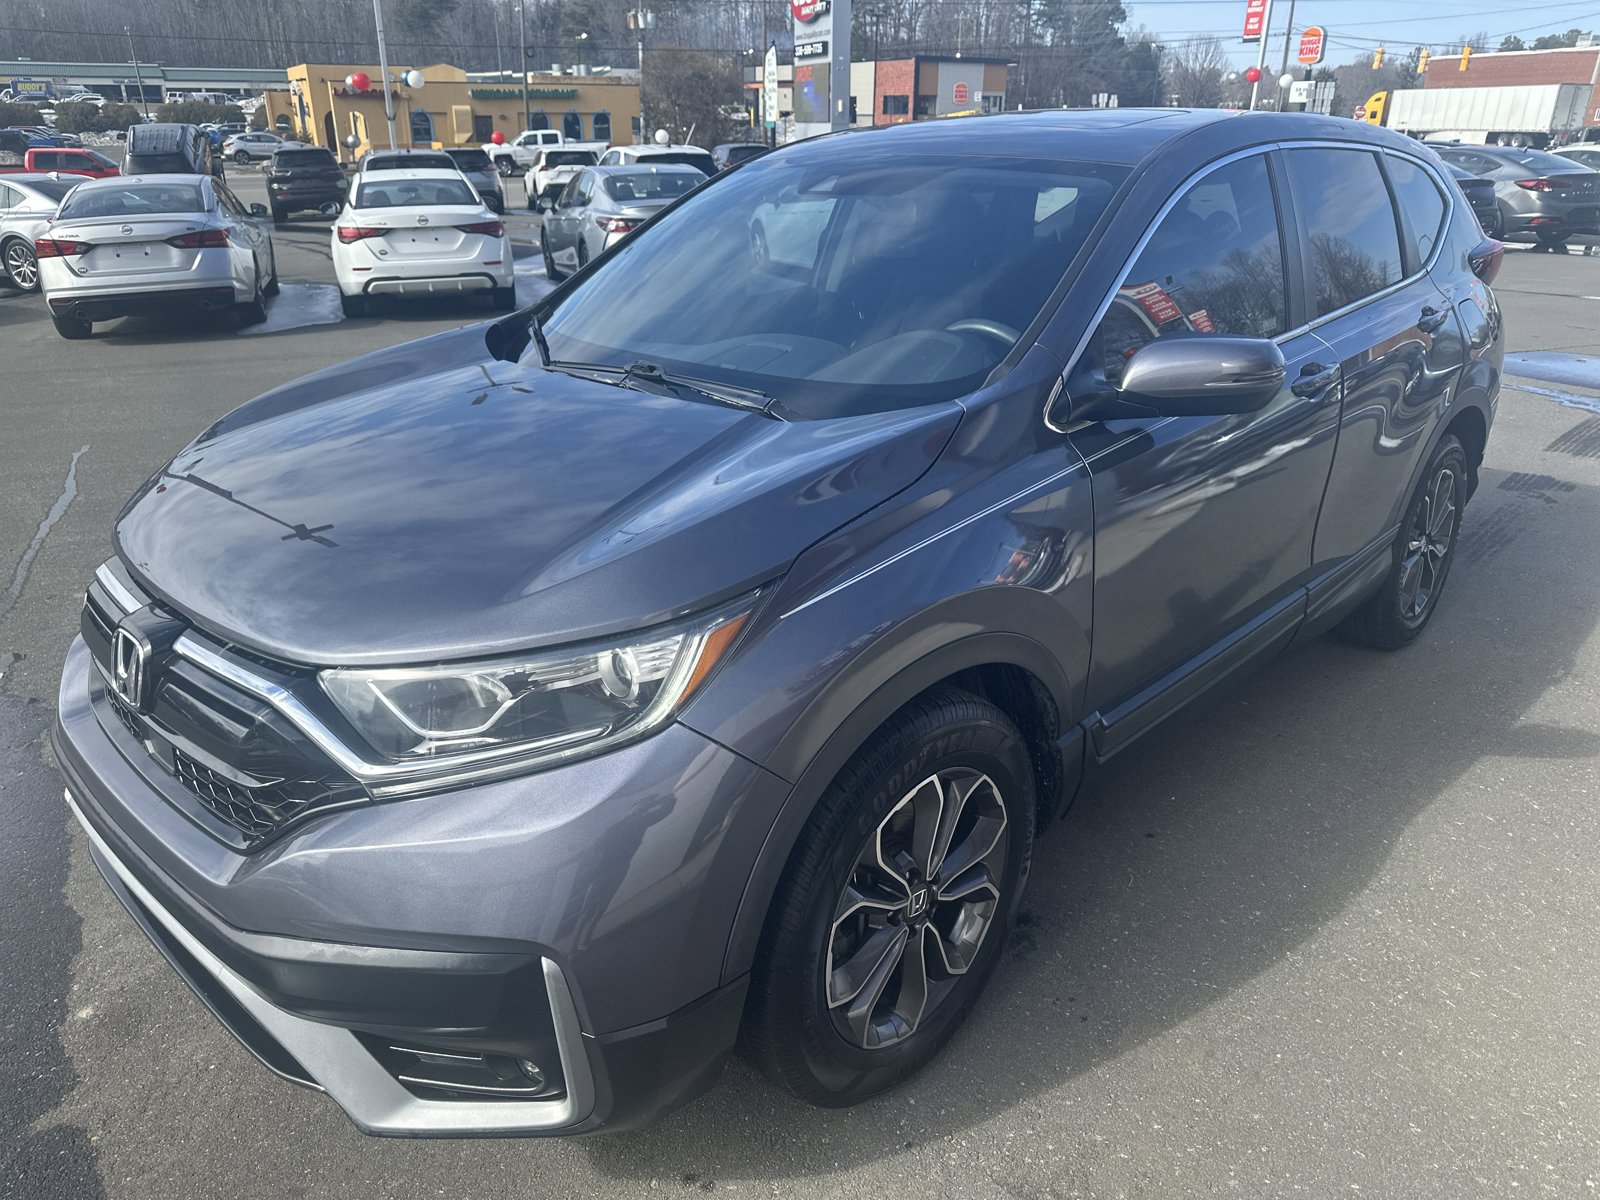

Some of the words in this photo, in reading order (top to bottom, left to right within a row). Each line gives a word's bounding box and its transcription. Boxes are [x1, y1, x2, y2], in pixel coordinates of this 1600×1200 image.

[1300, 38, 1320, 46] BURGER
[1299, 46, 1319, 56] KING
[17, 82, 47, 92] BUDDY'S
[859, 730, 988, 835] GOODYEAR
